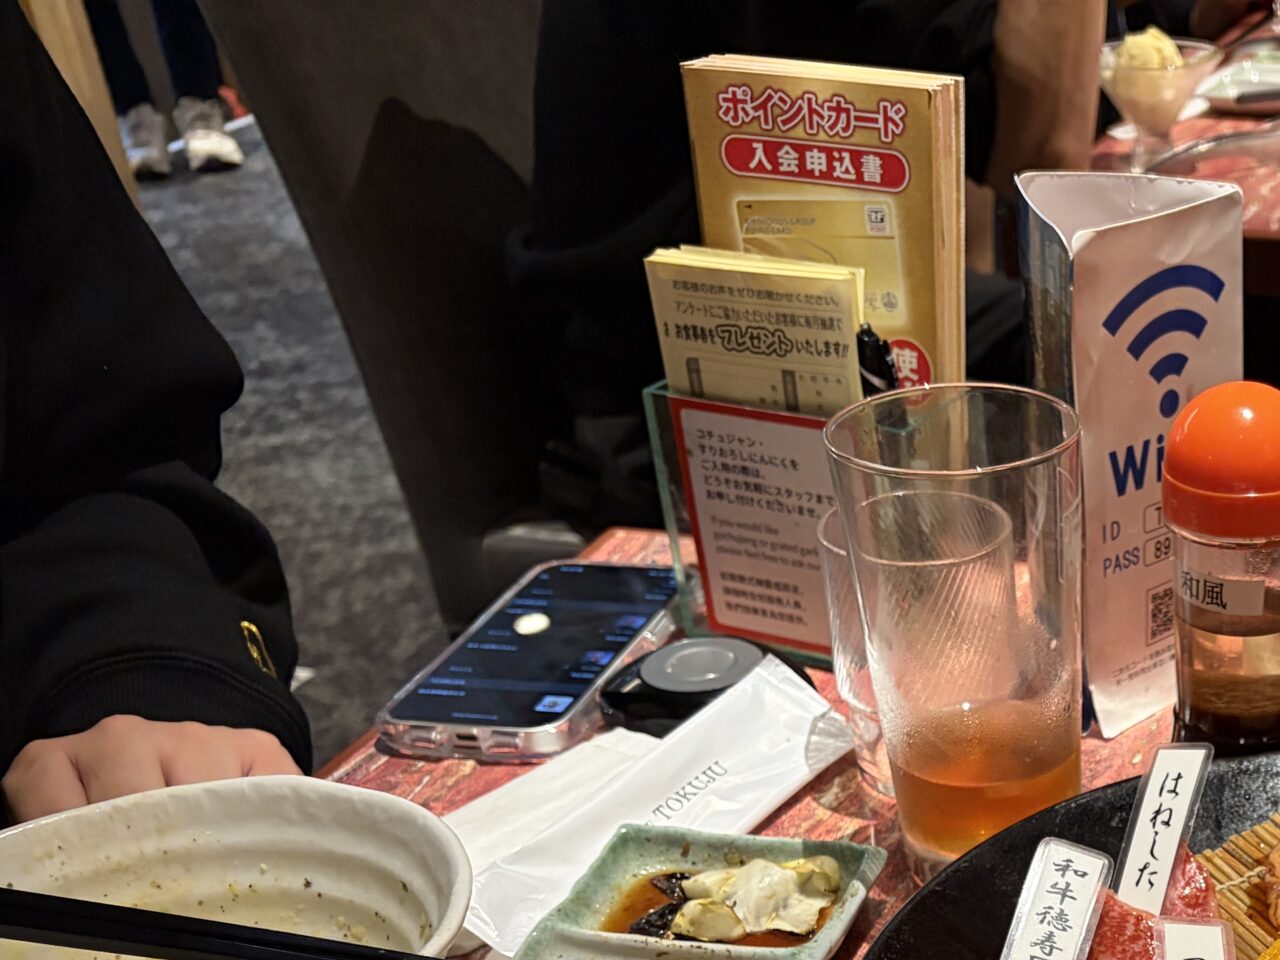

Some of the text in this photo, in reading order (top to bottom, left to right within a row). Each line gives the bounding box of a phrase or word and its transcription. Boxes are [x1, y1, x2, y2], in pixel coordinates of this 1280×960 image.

[718, 86, 907, 142] ポイントカード
[748, 143, 884, 183] 入会申込書
[1109, 434, 1164, 498] Wi
[1103, 521, 1121, 544] ID
[1103, 537, 1171, 579] PASS 89
[1181, 571, 1228, 609] 和風
[652, 760, 728, 820] TOKUJU
[1135, 772, 1182, 891] はねした
